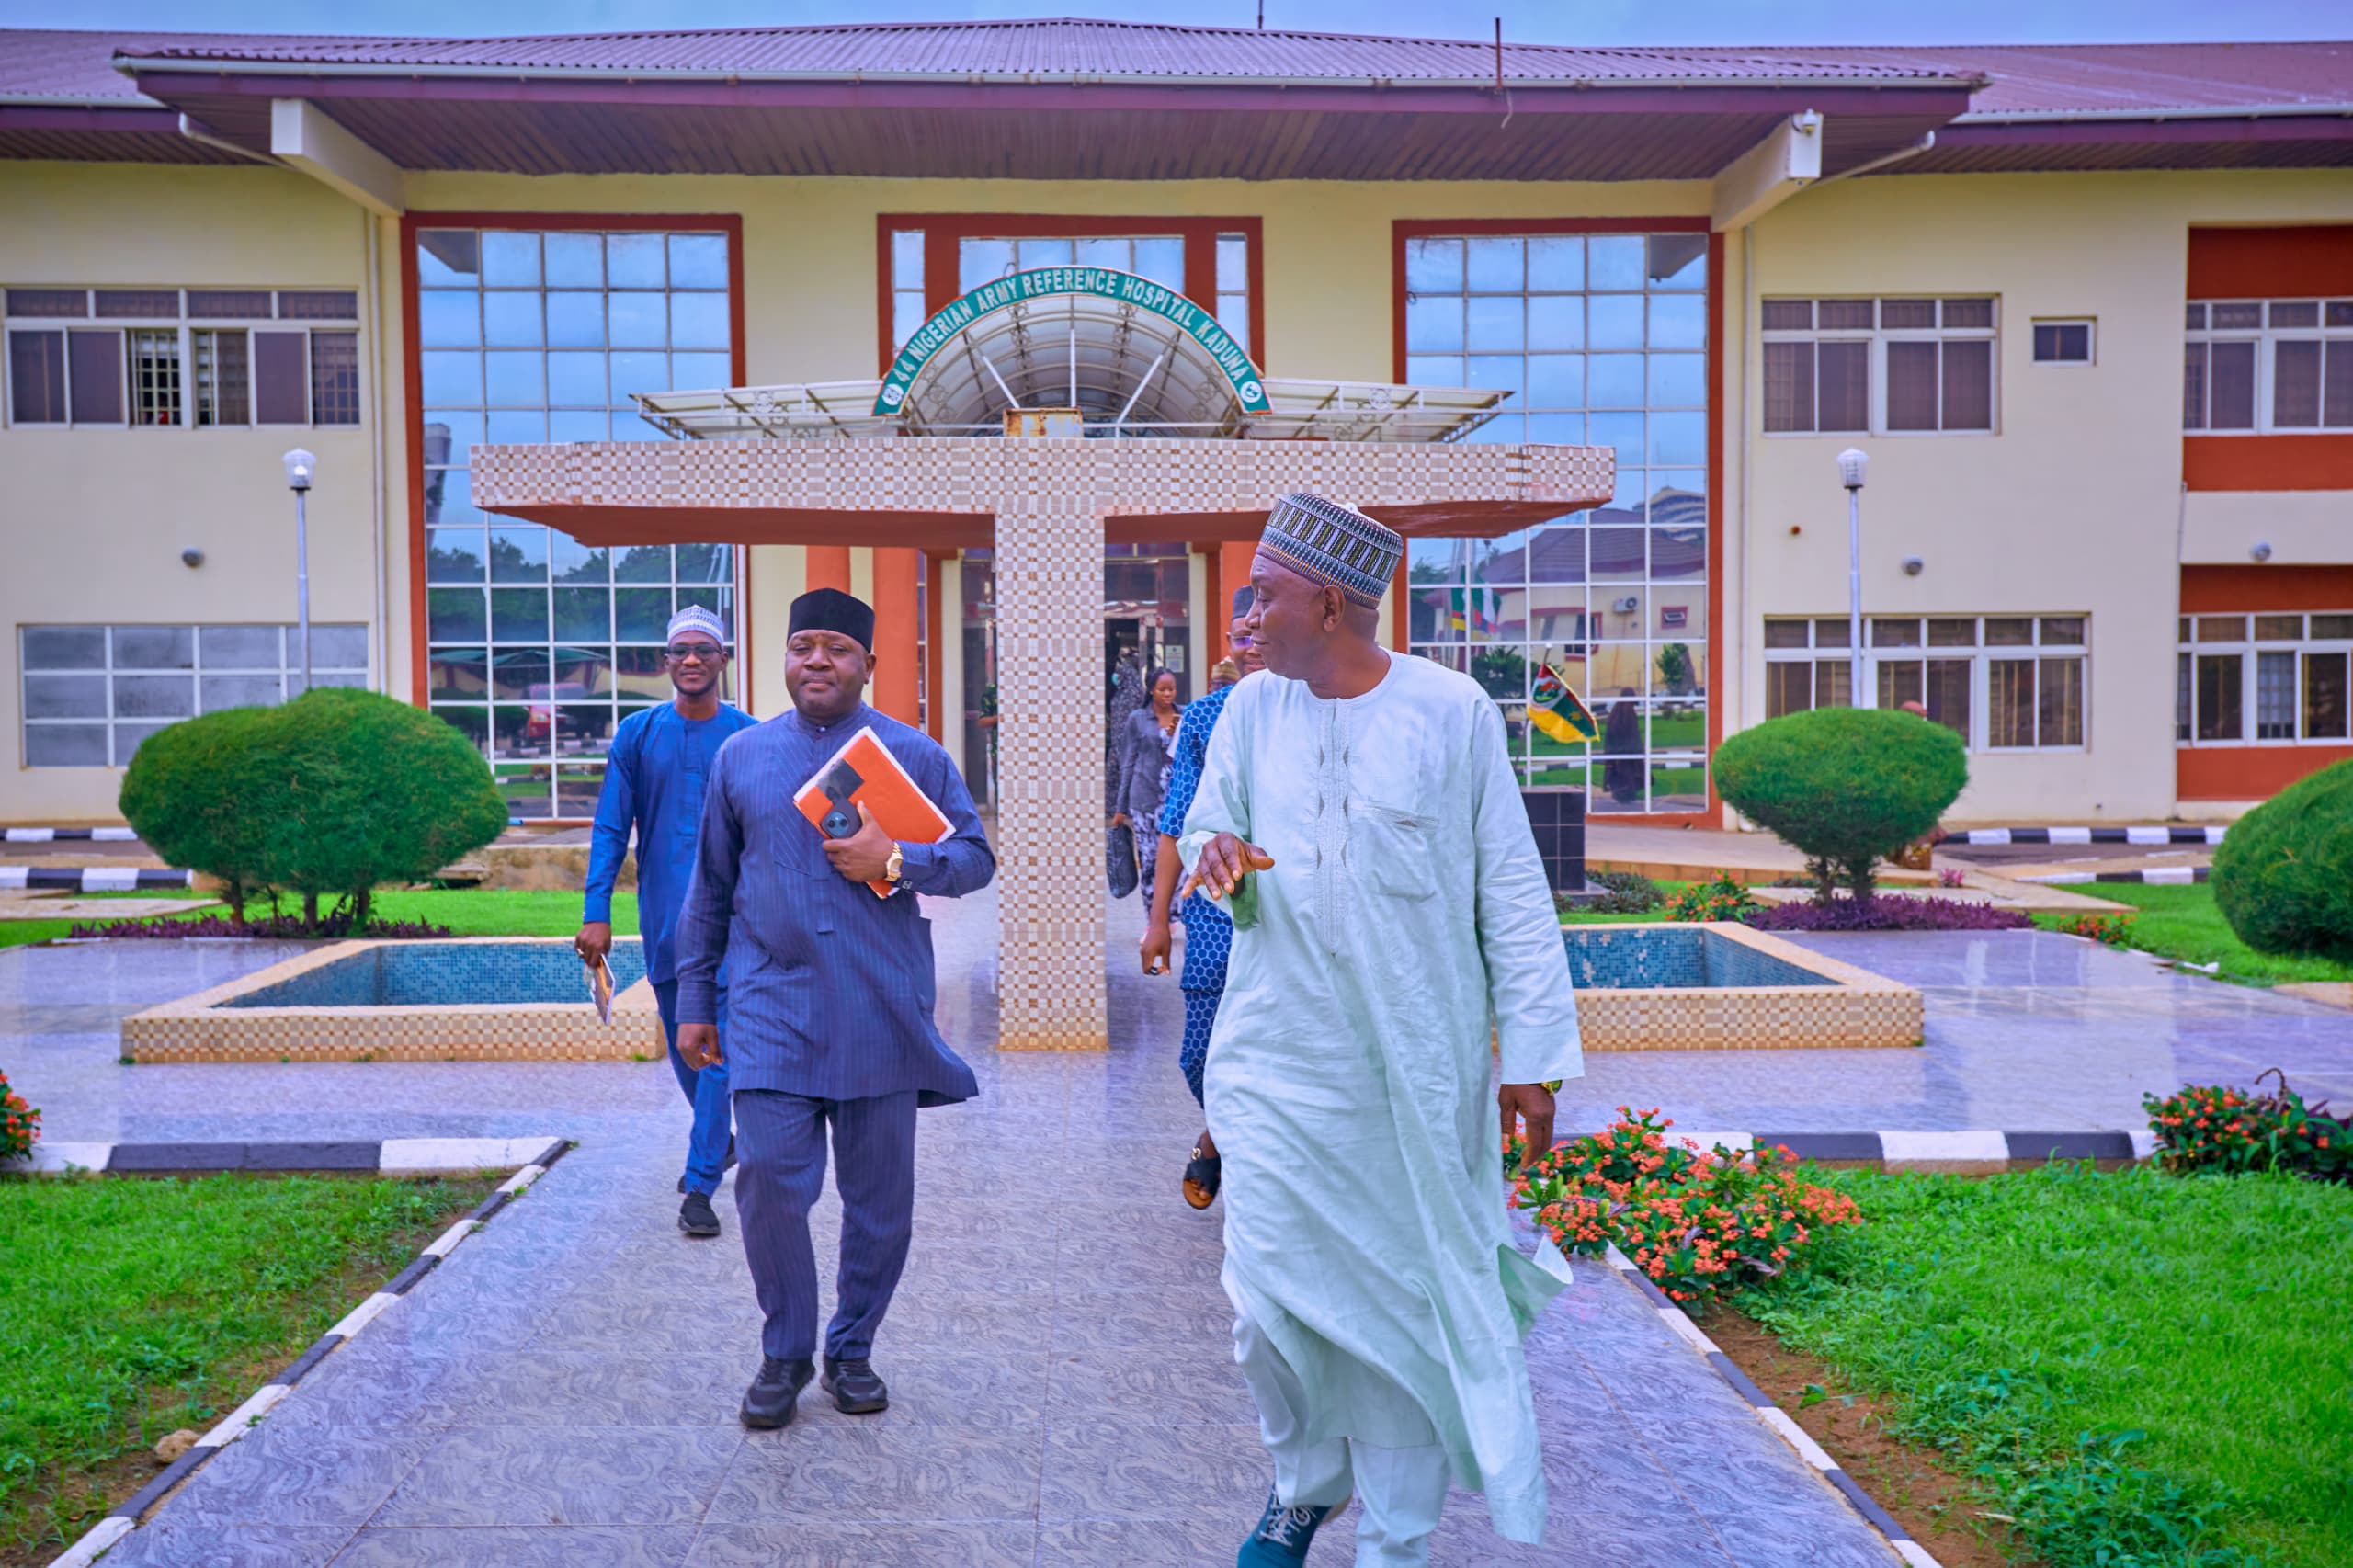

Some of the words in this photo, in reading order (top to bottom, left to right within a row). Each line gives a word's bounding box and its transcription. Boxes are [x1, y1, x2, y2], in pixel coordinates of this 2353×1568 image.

[906, 301, 973, 362] NIGERIAN
[975, 278, 1017, 312] ARMY
[1022, 269, 1117, 296] REFERENCE
[1121, 278, 1196, 327] HOSPITAL
[1195, 320, 1250, 381] KADUNA
